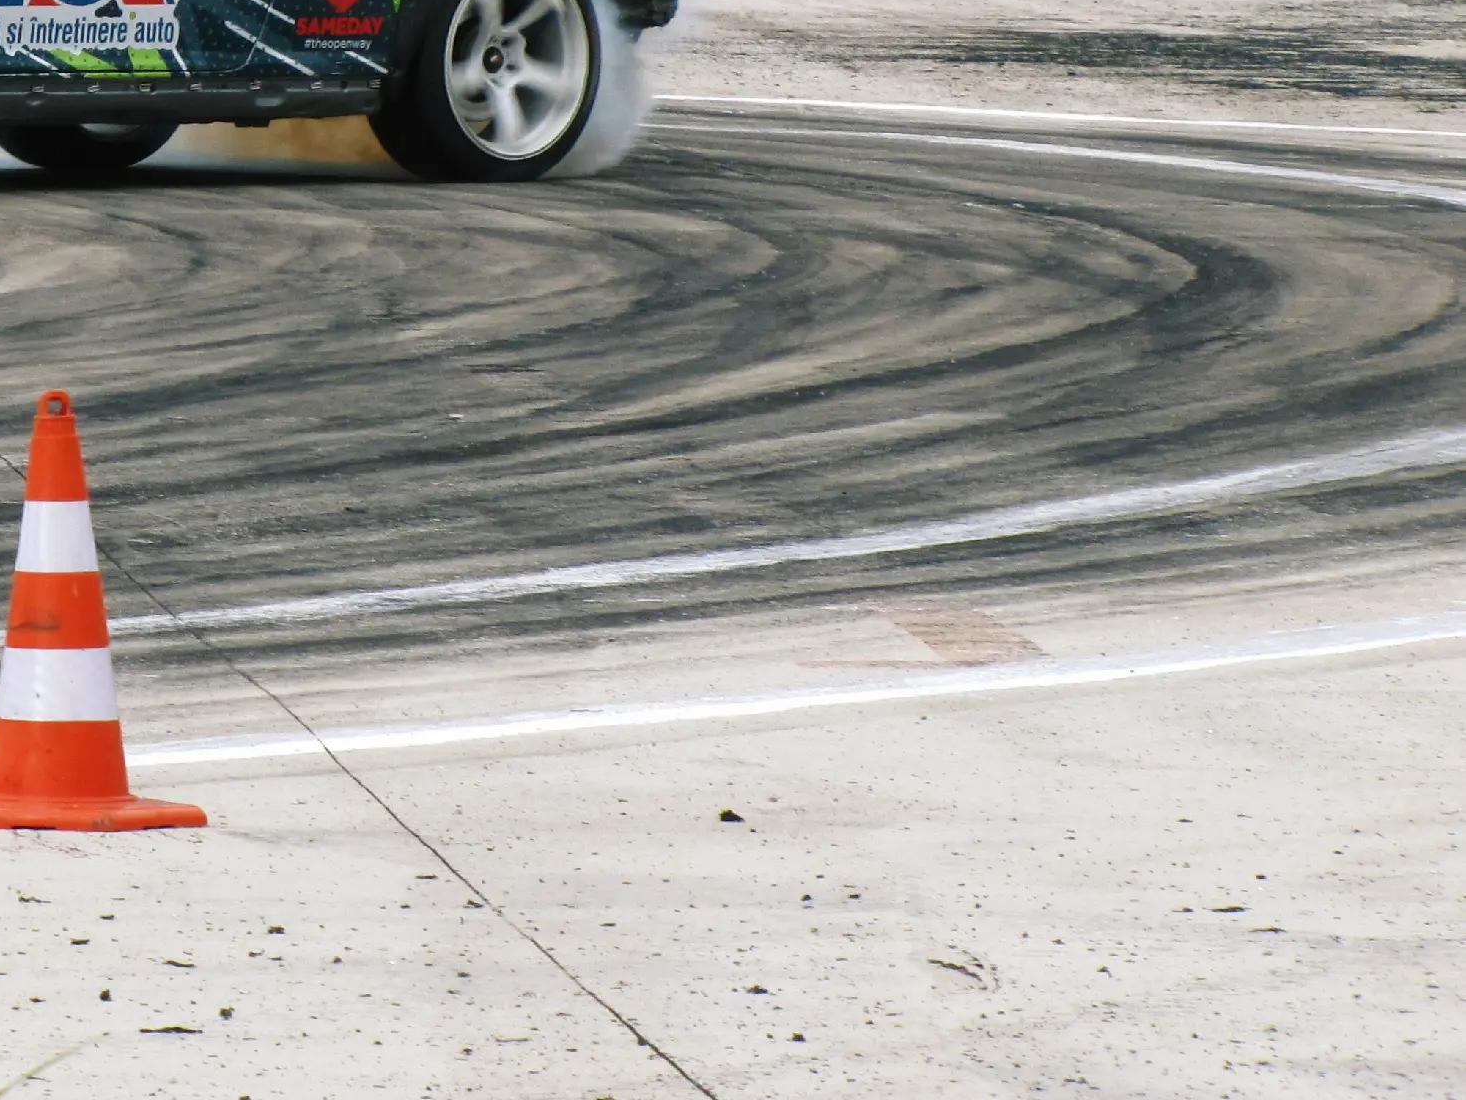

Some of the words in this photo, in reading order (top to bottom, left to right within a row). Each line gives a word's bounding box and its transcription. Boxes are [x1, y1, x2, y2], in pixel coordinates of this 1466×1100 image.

[134, 19, 175, 45] auto
[295, 17, 385, 36] SAMEDAY
[304, 38, 373, 51] #theopenway
